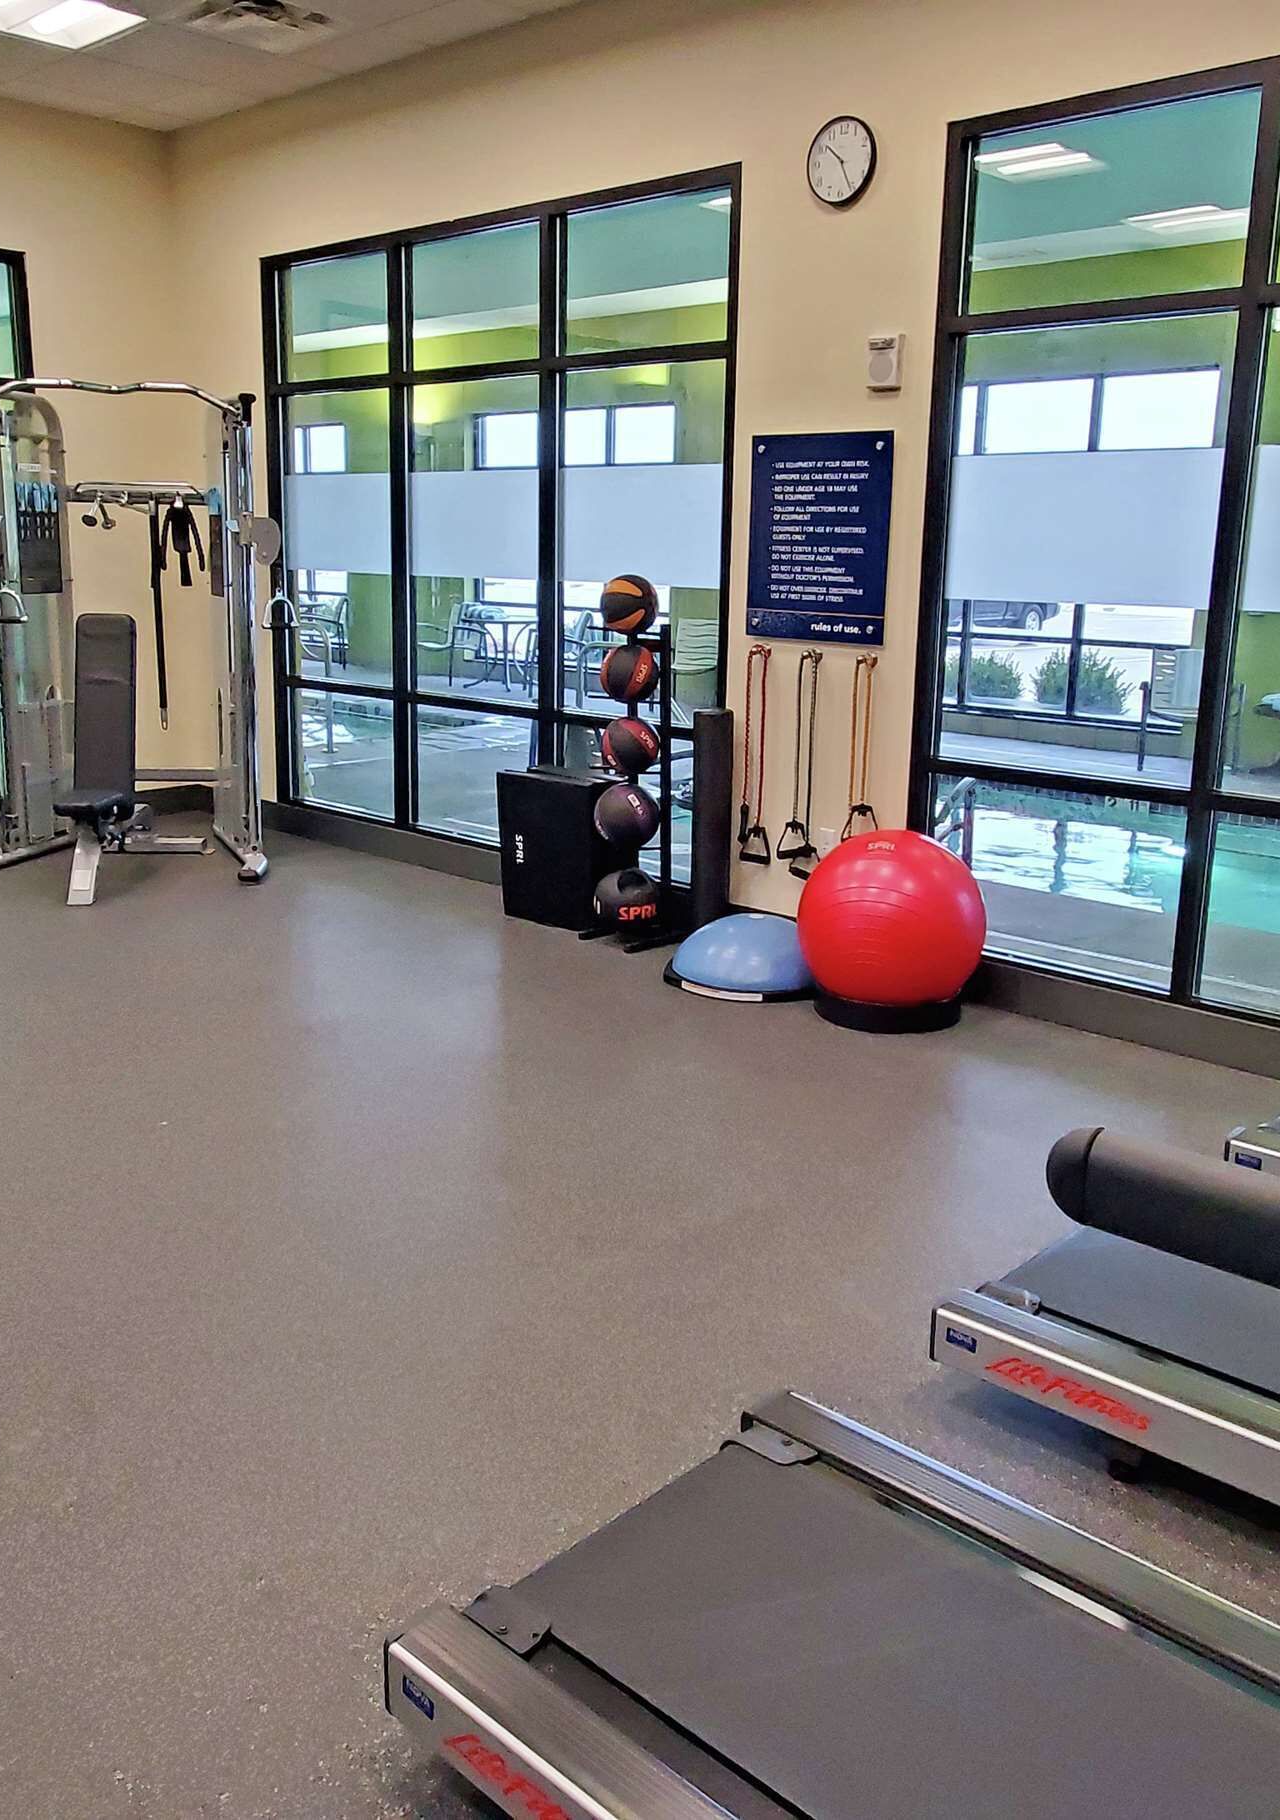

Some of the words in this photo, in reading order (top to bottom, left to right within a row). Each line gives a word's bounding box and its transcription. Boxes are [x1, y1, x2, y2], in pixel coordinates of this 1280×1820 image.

[811, 622, 831, 632] rules
[833, 623, 843, 632] of
[844, 626, 861, 634] use.
[640, 730, 654, 749] SPRI
[515, 834, 524, 864] SPRI
[618, 903, 656, 920] SPRI
